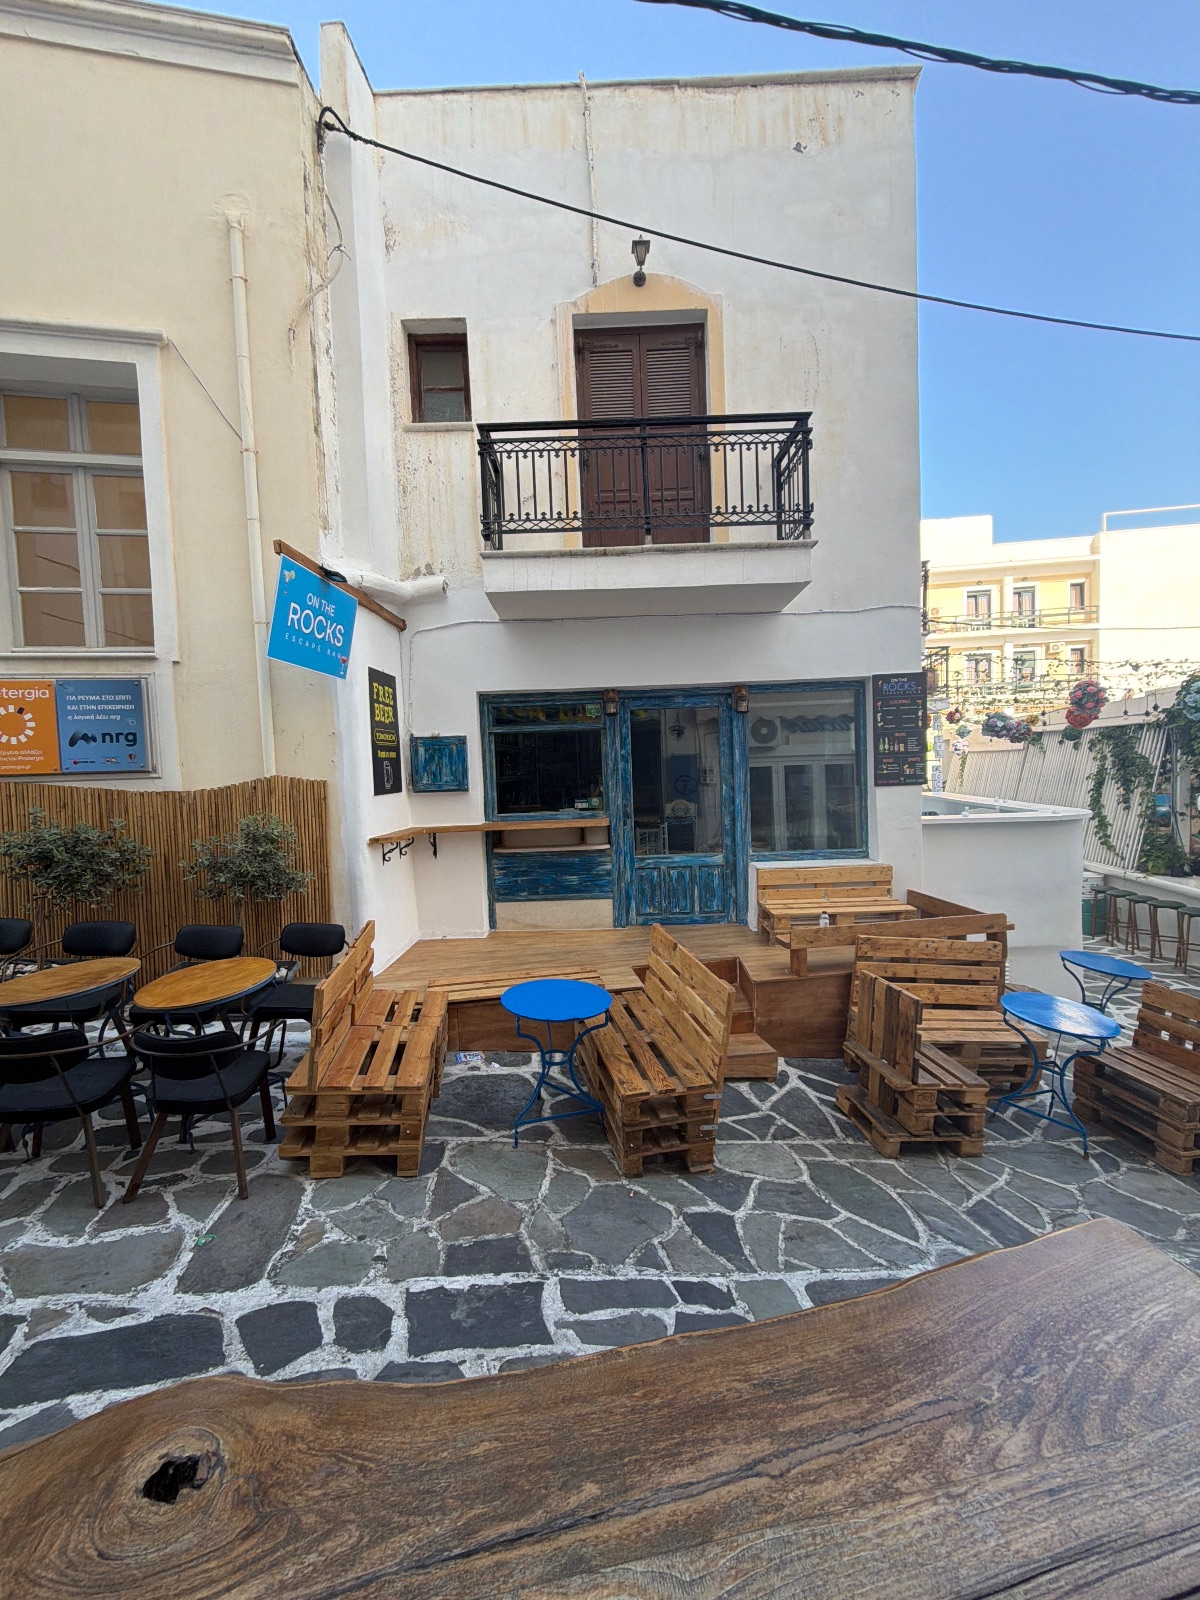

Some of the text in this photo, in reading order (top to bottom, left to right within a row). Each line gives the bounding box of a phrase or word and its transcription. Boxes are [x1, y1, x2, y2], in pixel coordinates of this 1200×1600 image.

[307, 593, 336, 617] ON THE
[287, 602, 344, 647] ROCKS
[285, 632, 342, 659] ESCAPE BAR
[0, 687, 49, 701] tergia
[372, 682, 394, 706] FREE
[882, 681, 917, 692] ROCKS
[373, 703, 395, 724] BEER
[101, 732, 138, 747] nrg
